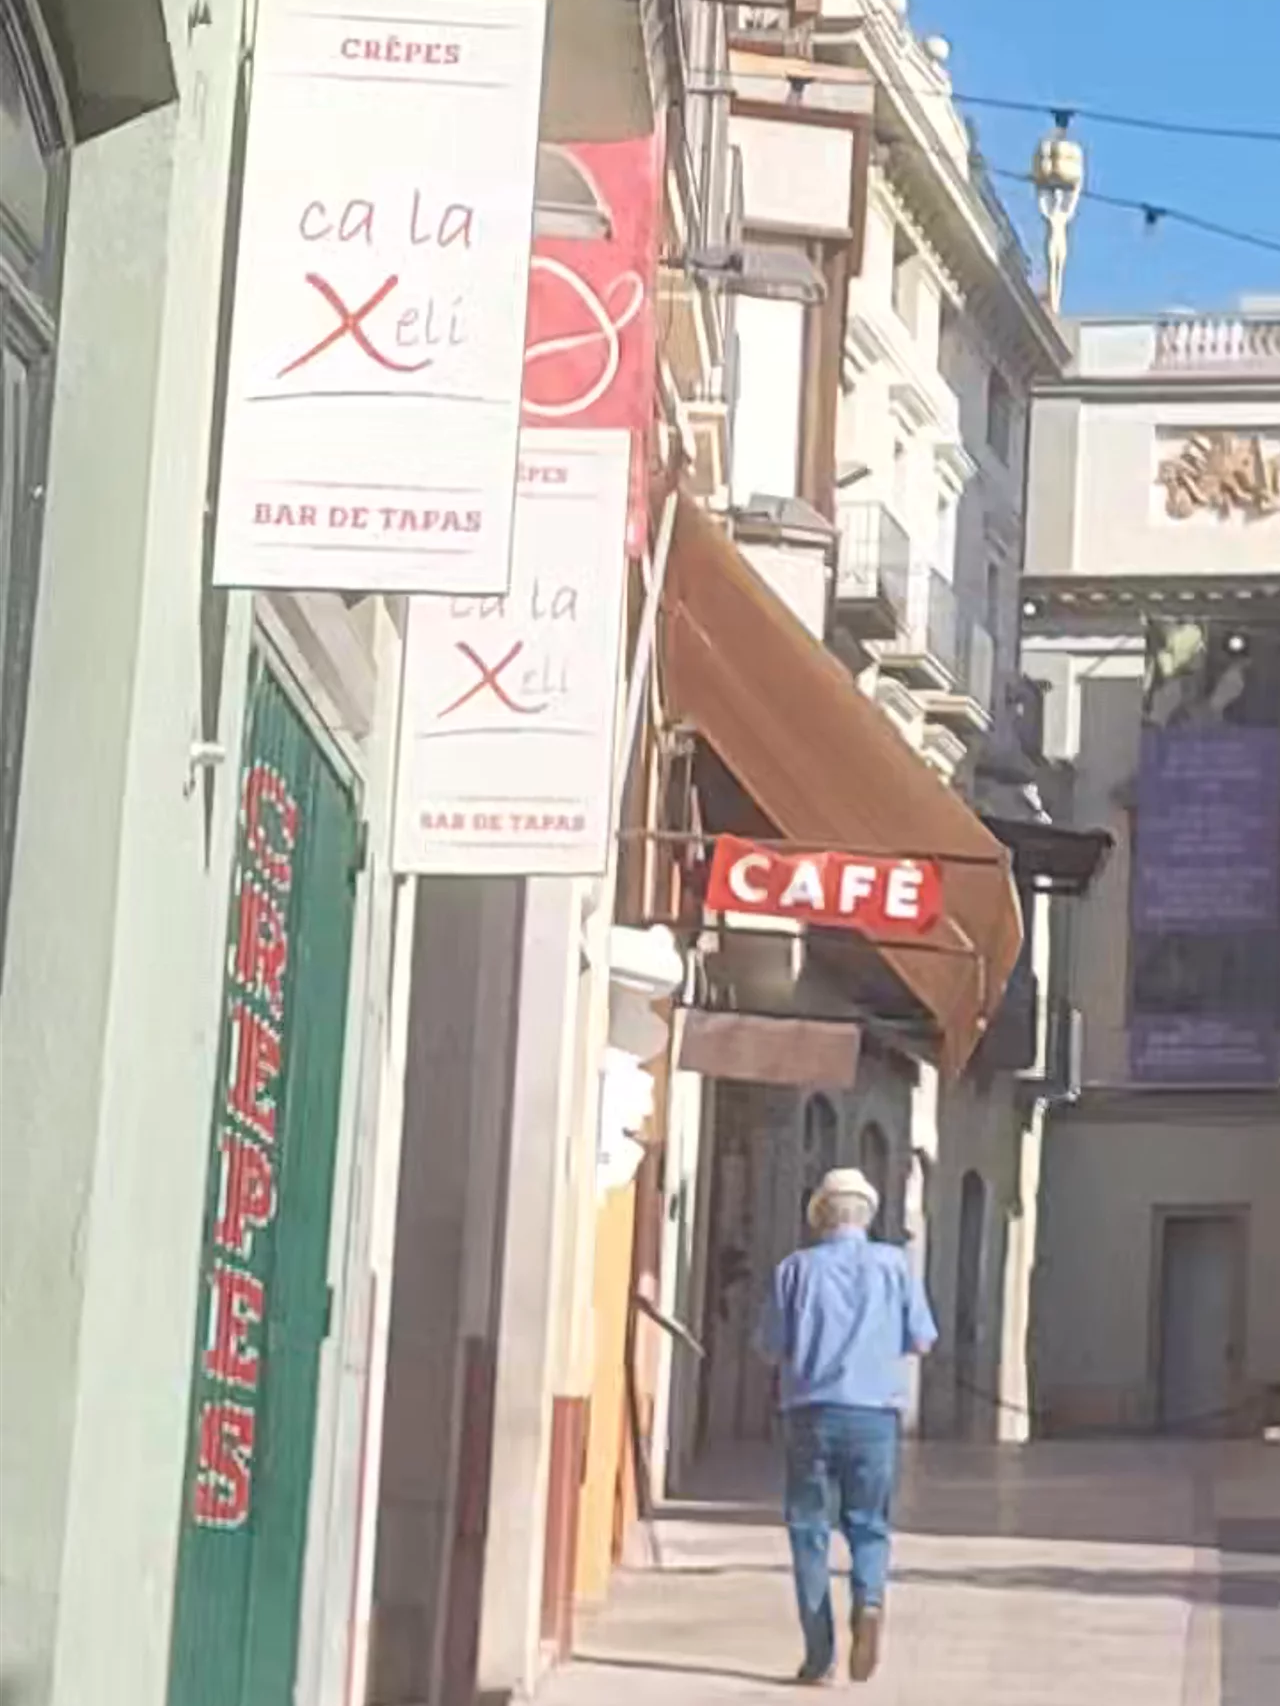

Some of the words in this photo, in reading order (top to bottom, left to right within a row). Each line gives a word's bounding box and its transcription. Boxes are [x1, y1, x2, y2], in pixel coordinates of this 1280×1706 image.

[299, 199, 374, 246] ca
[409, 188, 474, 249] la
[251, 502, 318, 528] BAR
[328, 506, 368, 530] DE
[376, 507, 482, 533] TAPAS
[531, 576, 578, 622] la
